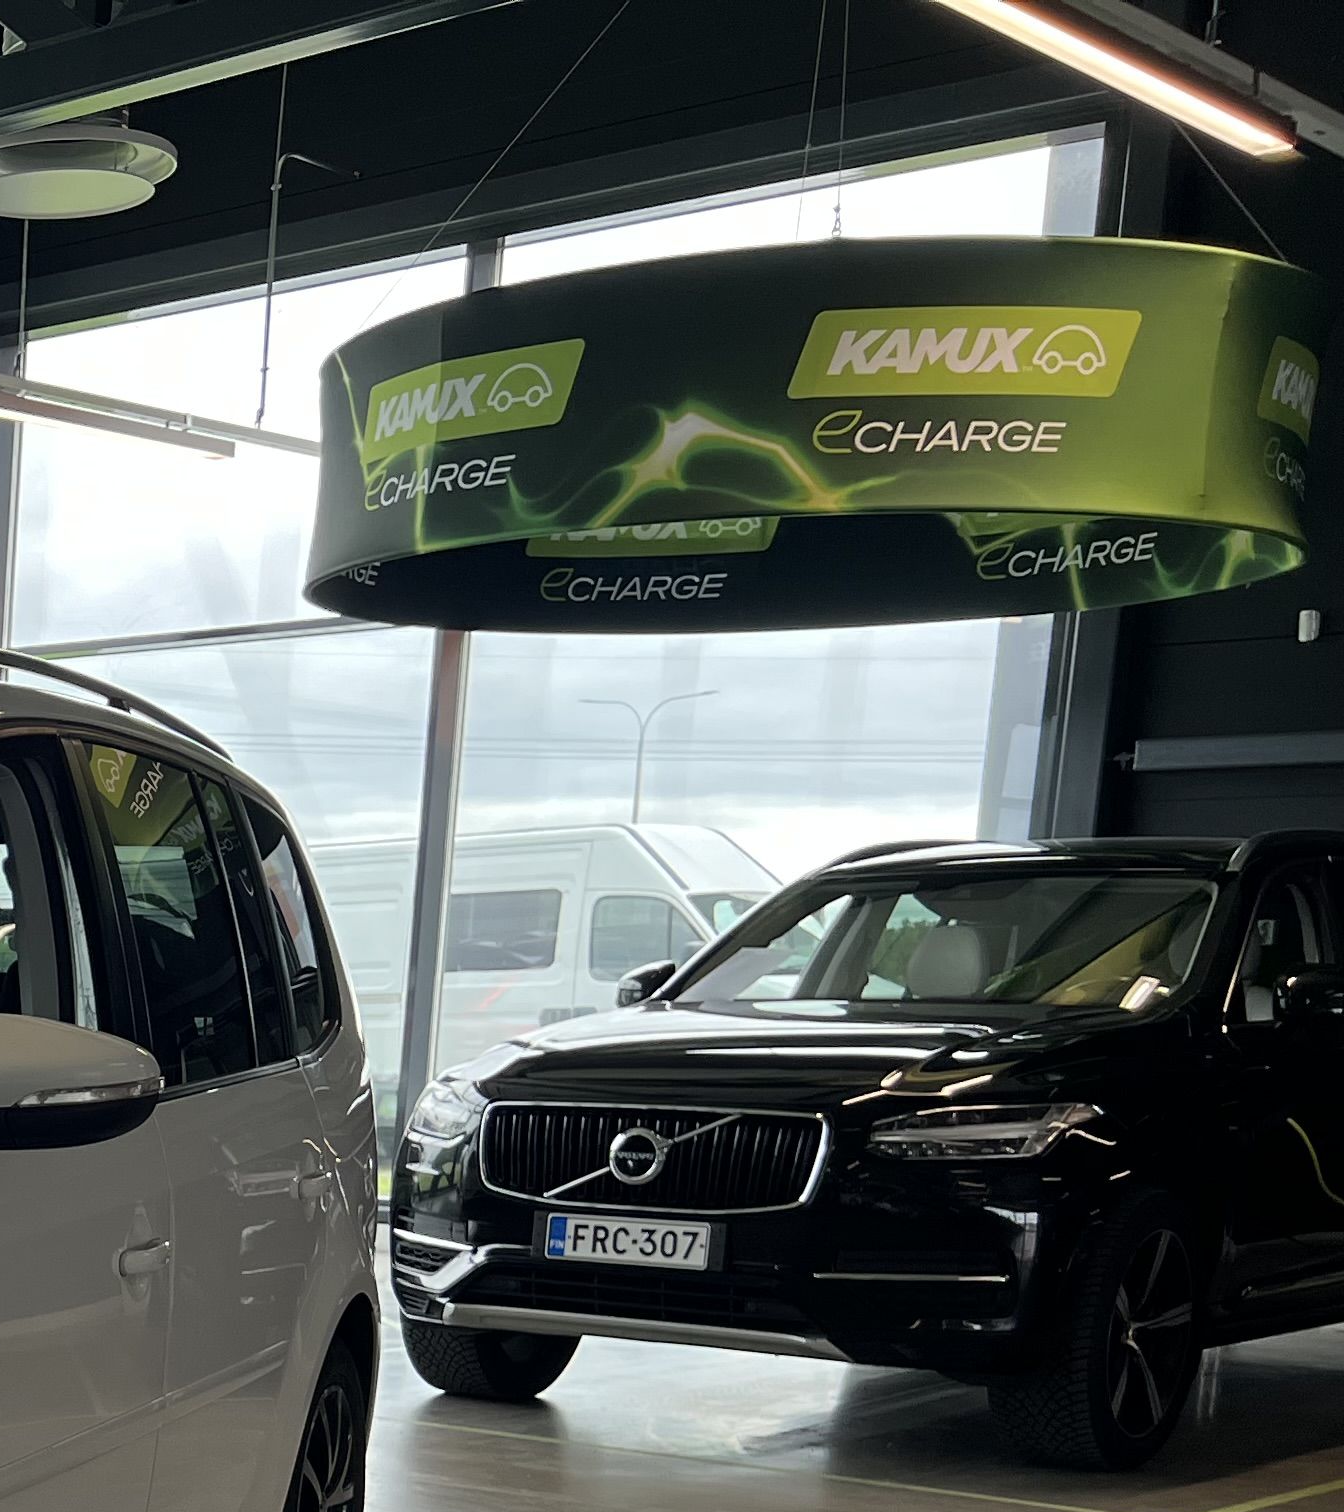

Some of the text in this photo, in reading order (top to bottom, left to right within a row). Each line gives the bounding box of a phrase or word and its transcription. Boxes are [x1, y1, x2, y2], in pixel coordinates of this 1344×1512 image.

[826, 328, 1034, 375] KAMUX
[375, 374, 486, 442] KAMUX
[813, 410, 1067, 453] eCHARGE
[364, 454, 516, 511] eCHARGE
[977, 532, 1158, 580] eCHARGE
[540, 568, 728, 601] eCHARGE
[550, 1224, 700, 1260] FIN FRC-307
